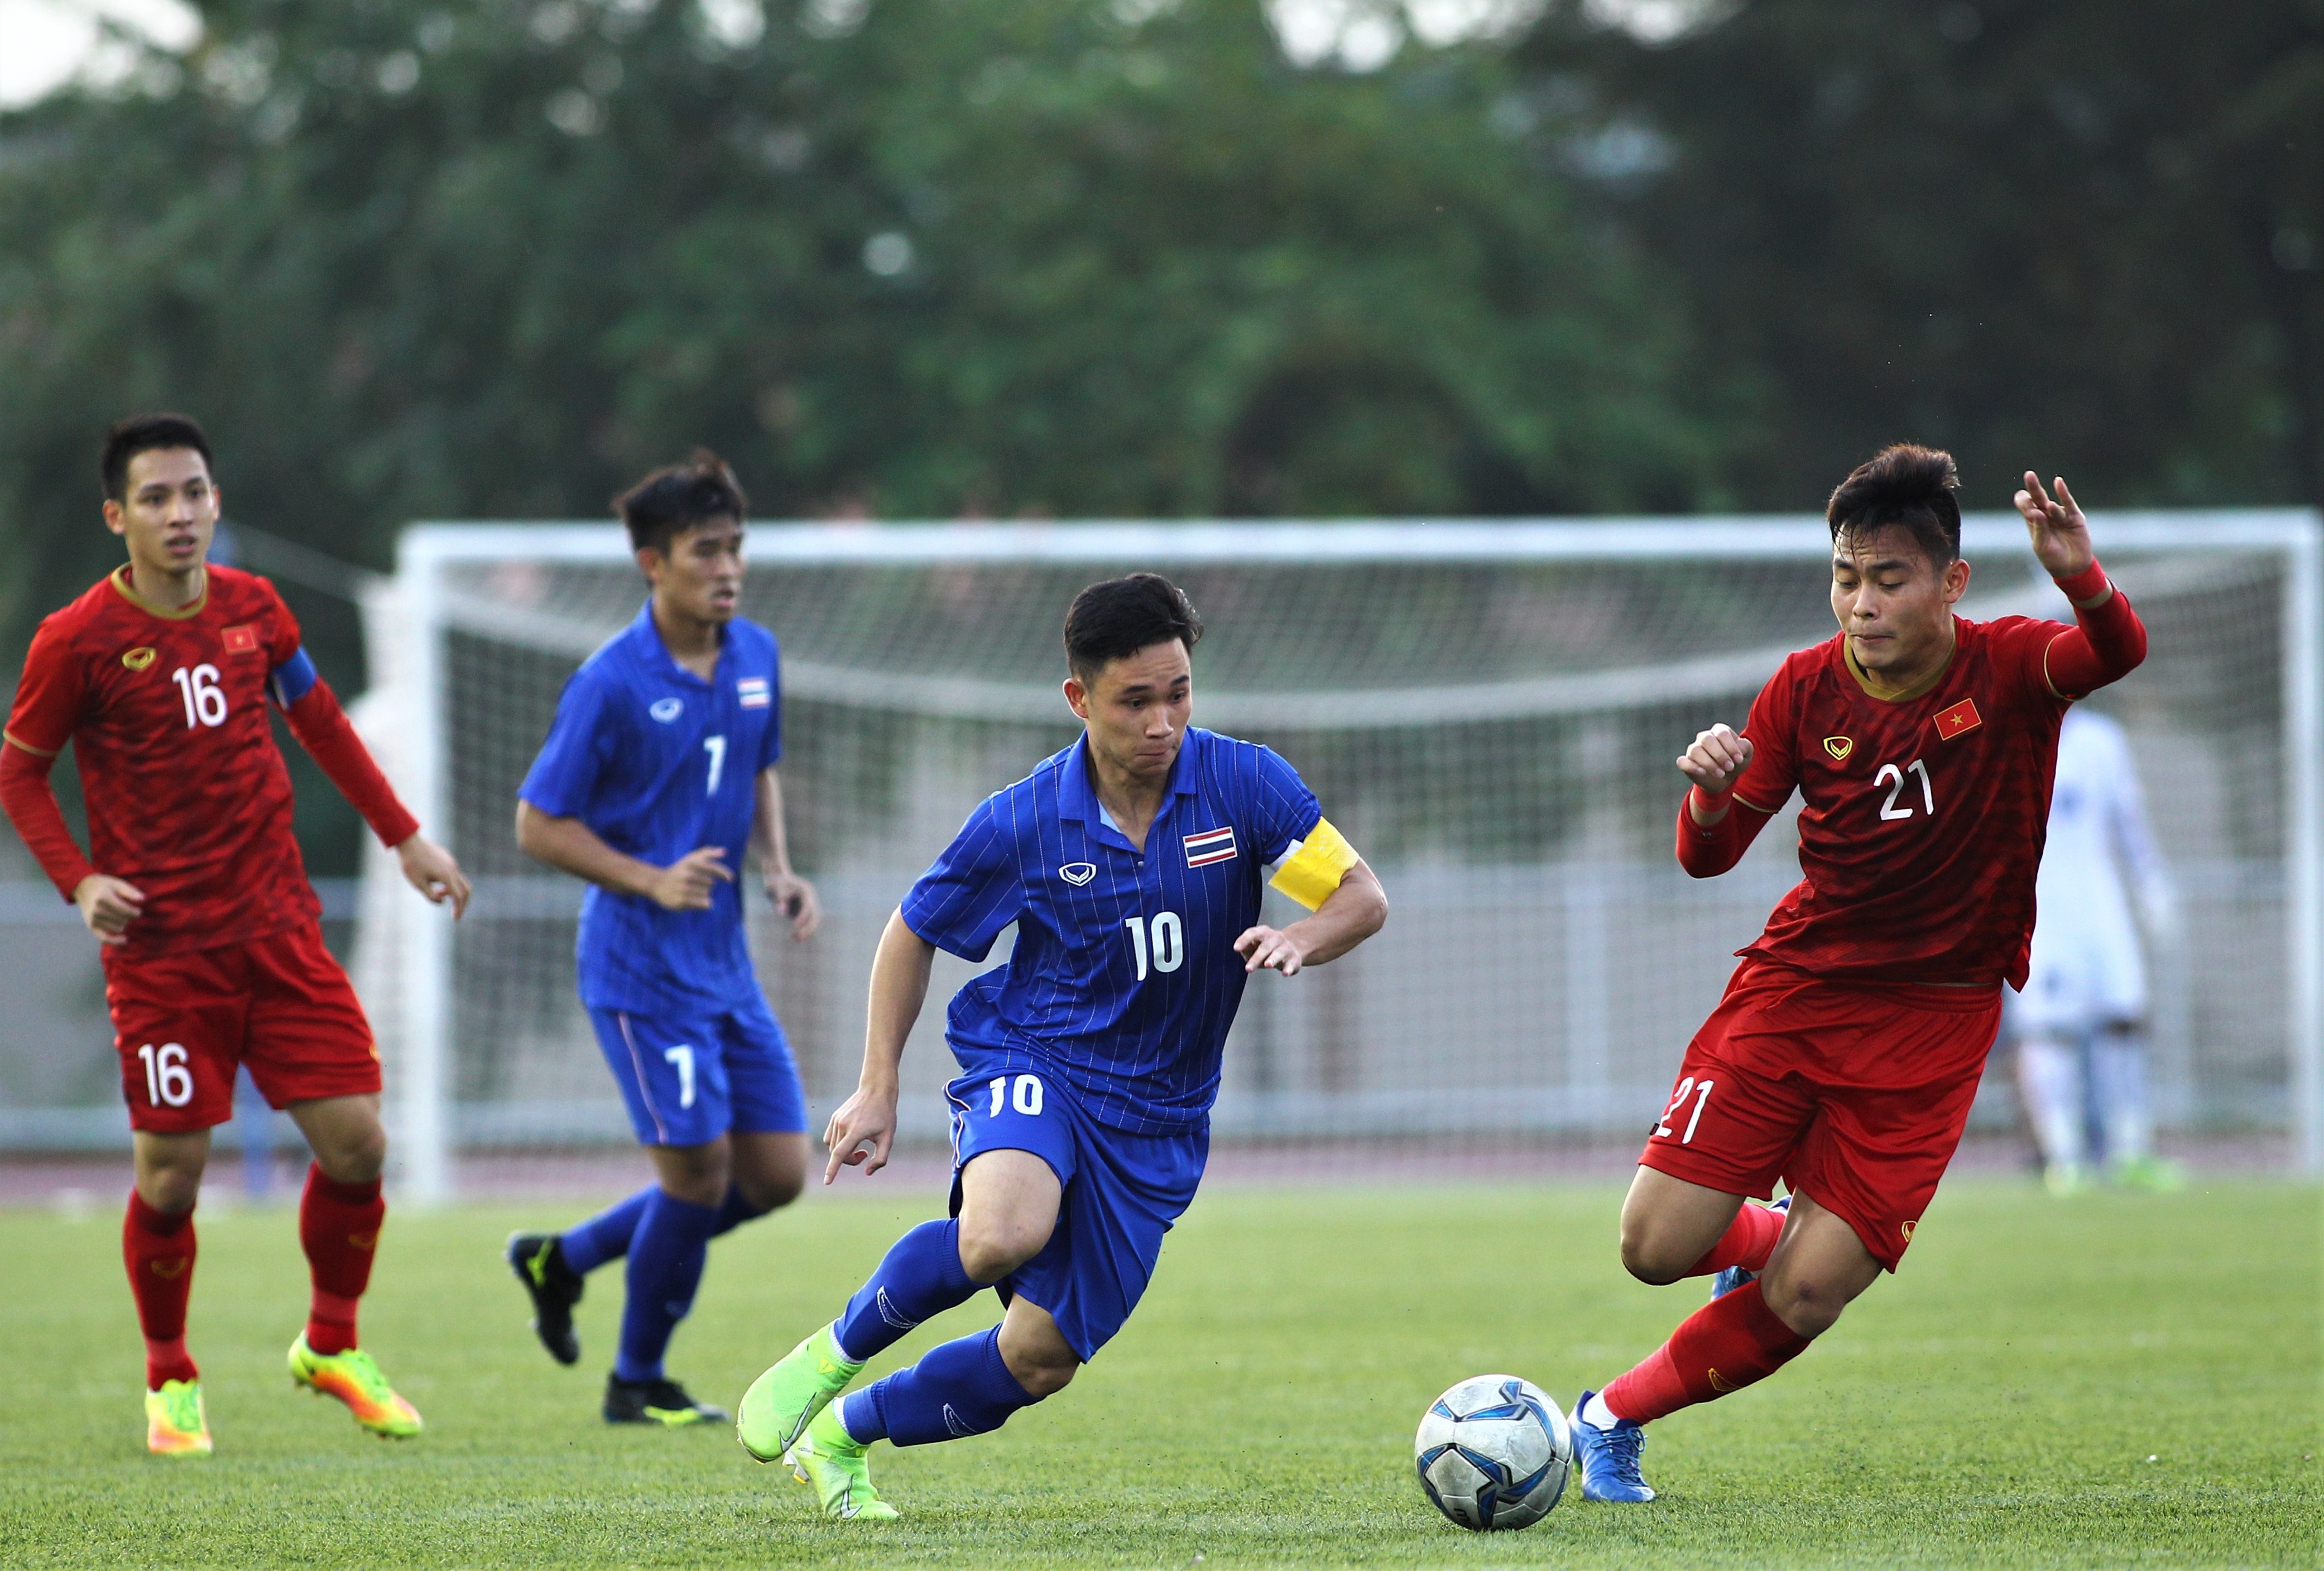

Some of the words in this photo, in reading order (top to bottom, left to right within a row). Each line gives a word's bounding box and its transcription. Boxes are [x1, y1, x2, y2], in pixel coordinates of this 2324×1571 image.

[172, 663, 228, 729] 16
[1873, 759, 1934, 821] 21
[1125, 911, 1183, 981] 10
[138, 1043, 193, 1107] 16
[989, 1074, 1044, 1118] 10
[1654, 1076, 1715, 1144] 21
